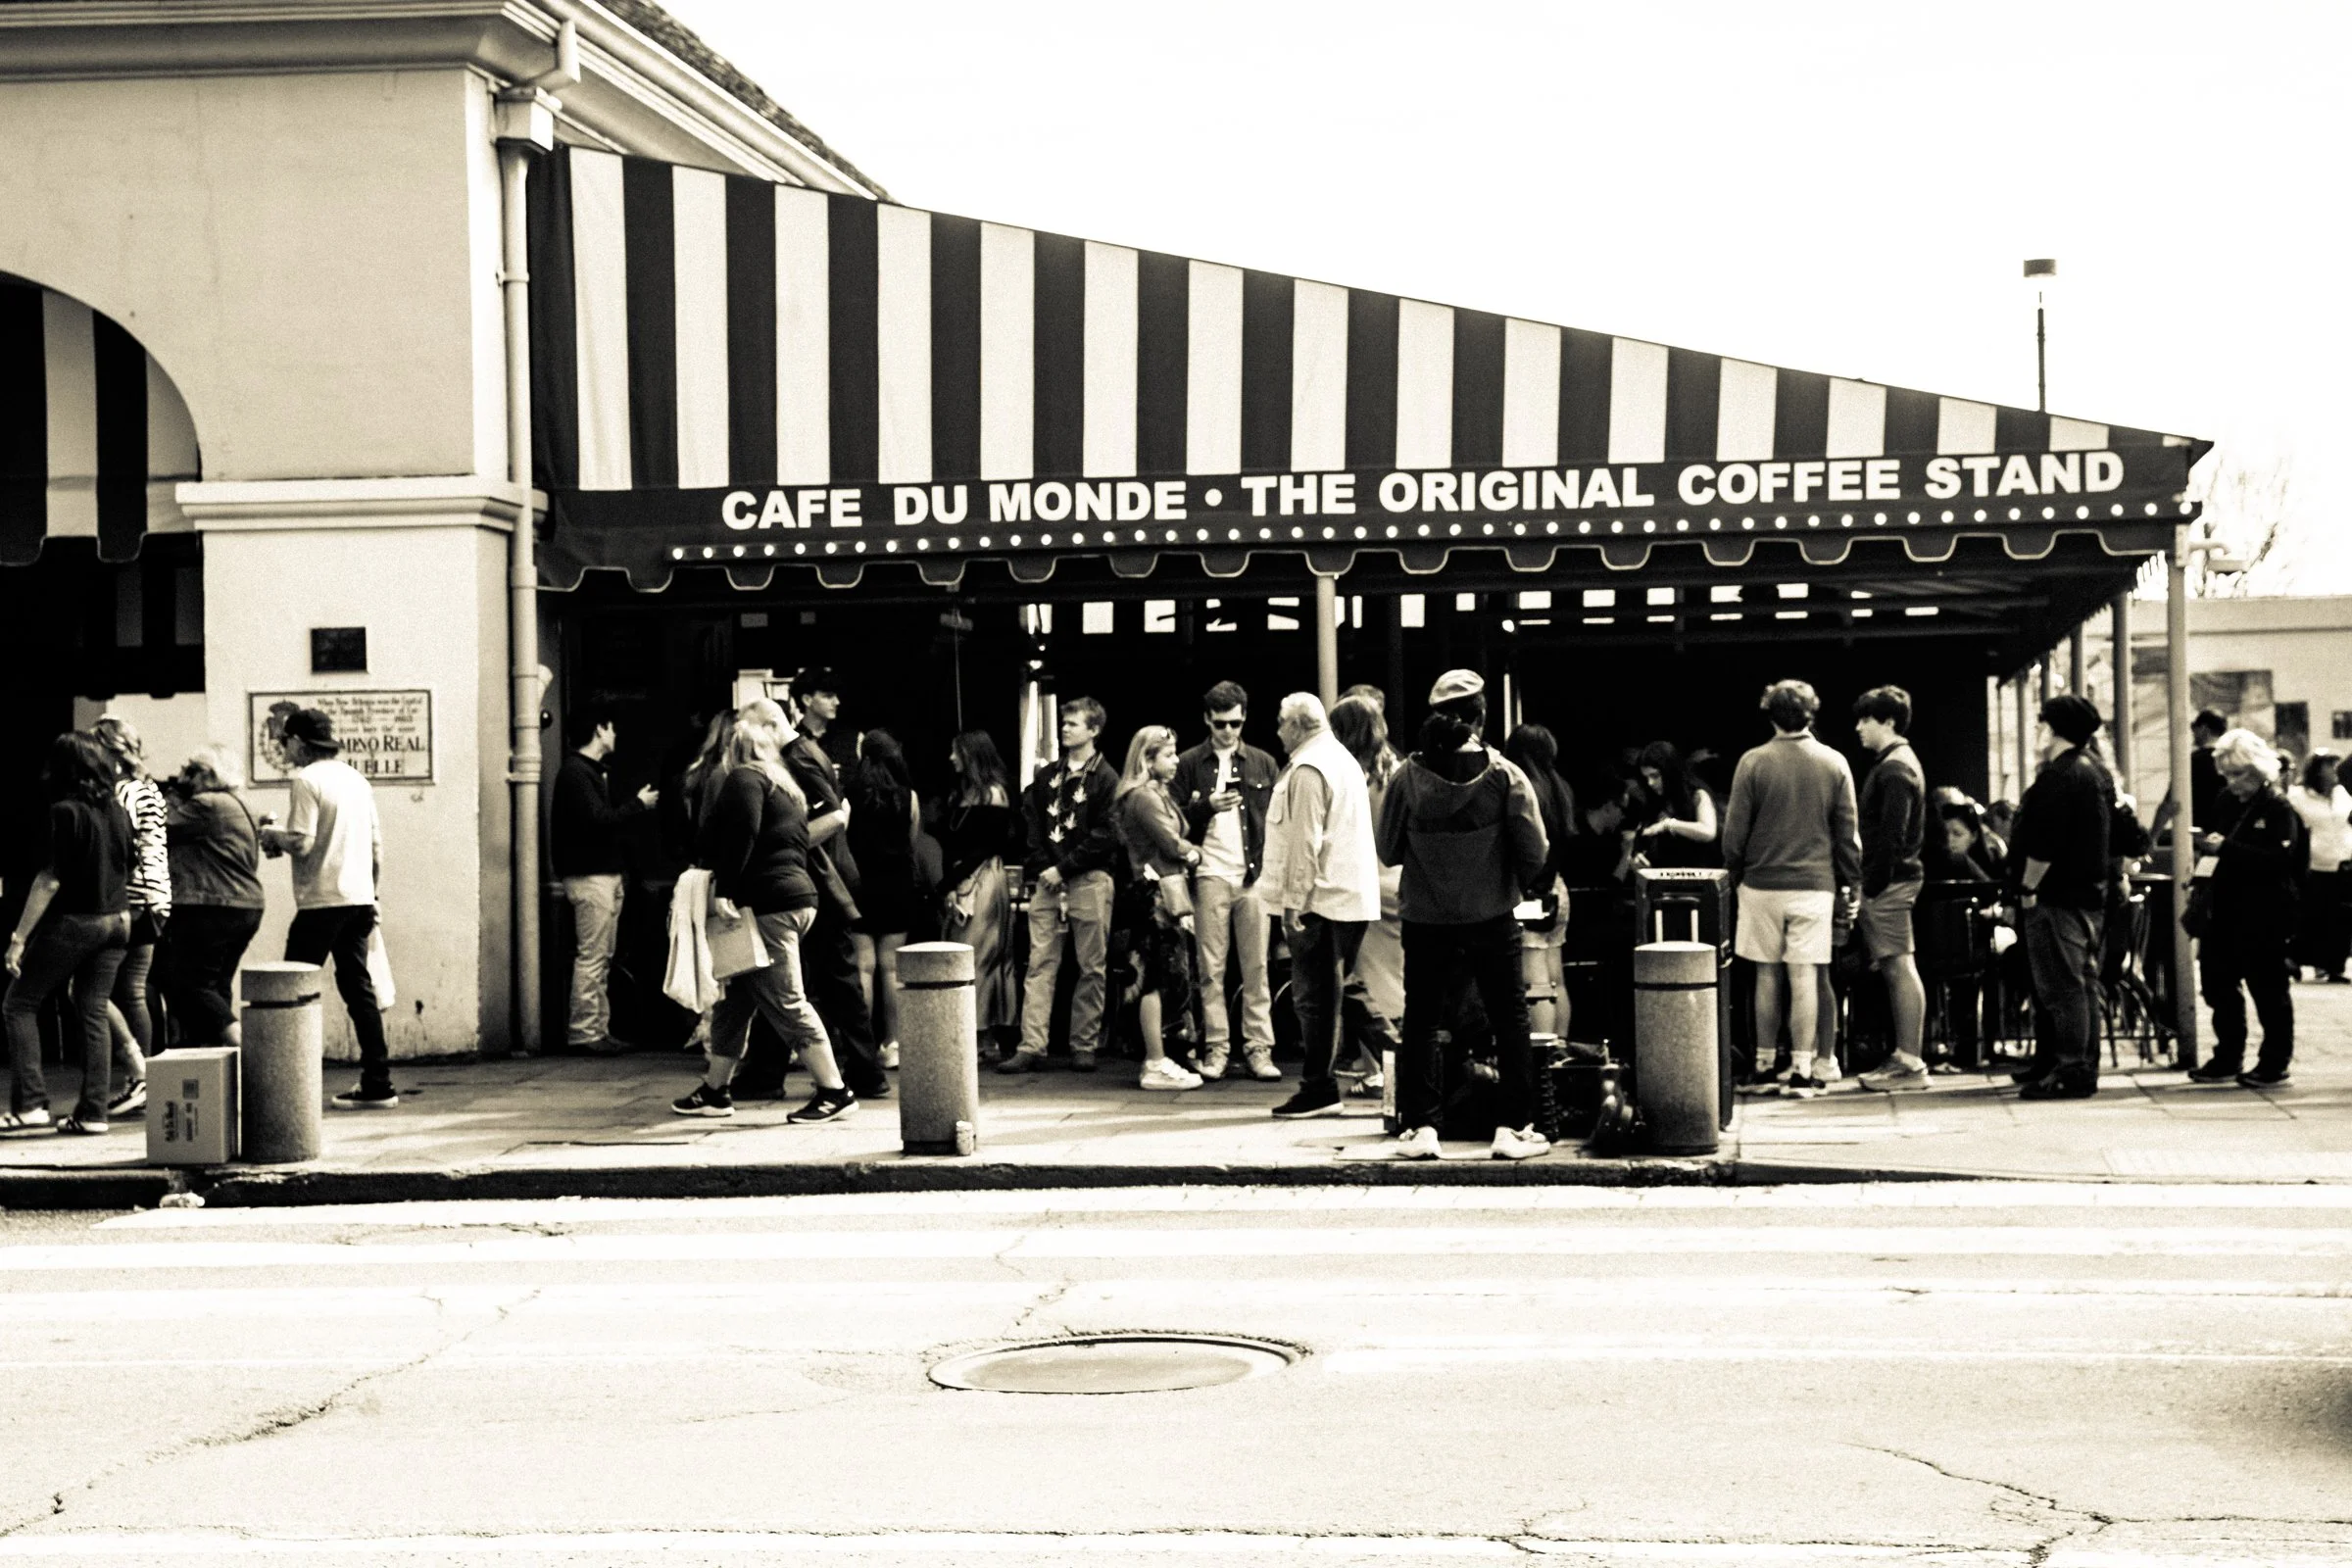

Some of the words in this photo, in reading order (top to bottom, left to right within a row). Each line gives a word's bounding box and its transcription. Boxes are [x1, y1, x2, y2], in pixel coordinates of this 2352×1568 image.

[721, 489, 862, 530] CAFE
[894, 485, 968, 526] DU
[989, 481, 1188, 523] MONDE
[1241, 473, 1356, 517] THE
[1378, 467, 1655, 513] ORIGINAL
[1678, 459, 1901, 506] COFFEE
[1924, 451, 2125, 500] STAND
[338, 735, 380, 754] MINO
[382, 734, 425, 753] REAL
[346, 758, 405, 774] UELLE
